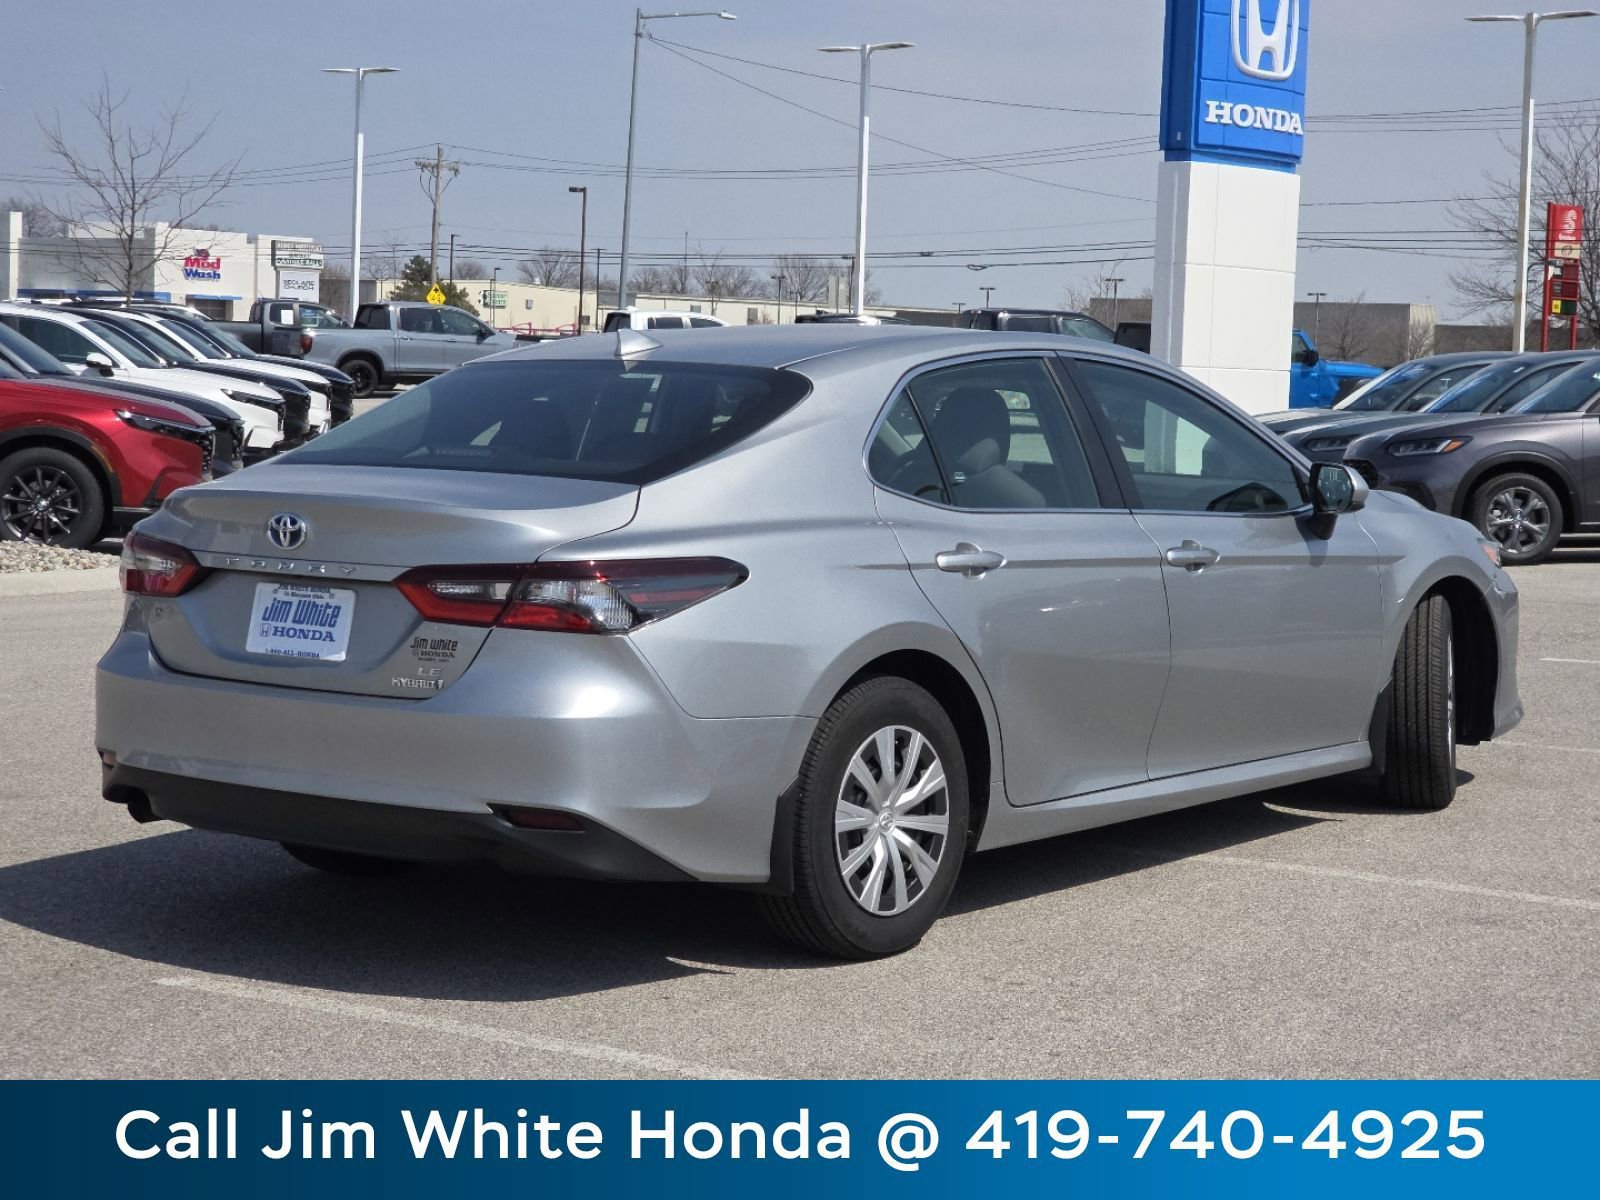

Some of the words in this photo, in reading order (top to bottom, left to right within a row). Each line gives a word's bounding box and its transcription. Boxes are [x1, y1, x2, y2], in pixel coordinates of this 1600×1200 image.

[1204, 100, 1304, 136] HONDA
[184, 256, 221, 269] Mod
[183, 268, 221, 280] Wash
[262, 597, 293, 623] Jim
[292, 599, 342, 628] White
[272, 625, 336, 642] HONDA
[410, 636, 429, 649] Jim
[420, 650, 455, 658] HONDA
[418, 667, 442, 677] LE
[391, 677, 436, 689] HYBRID
